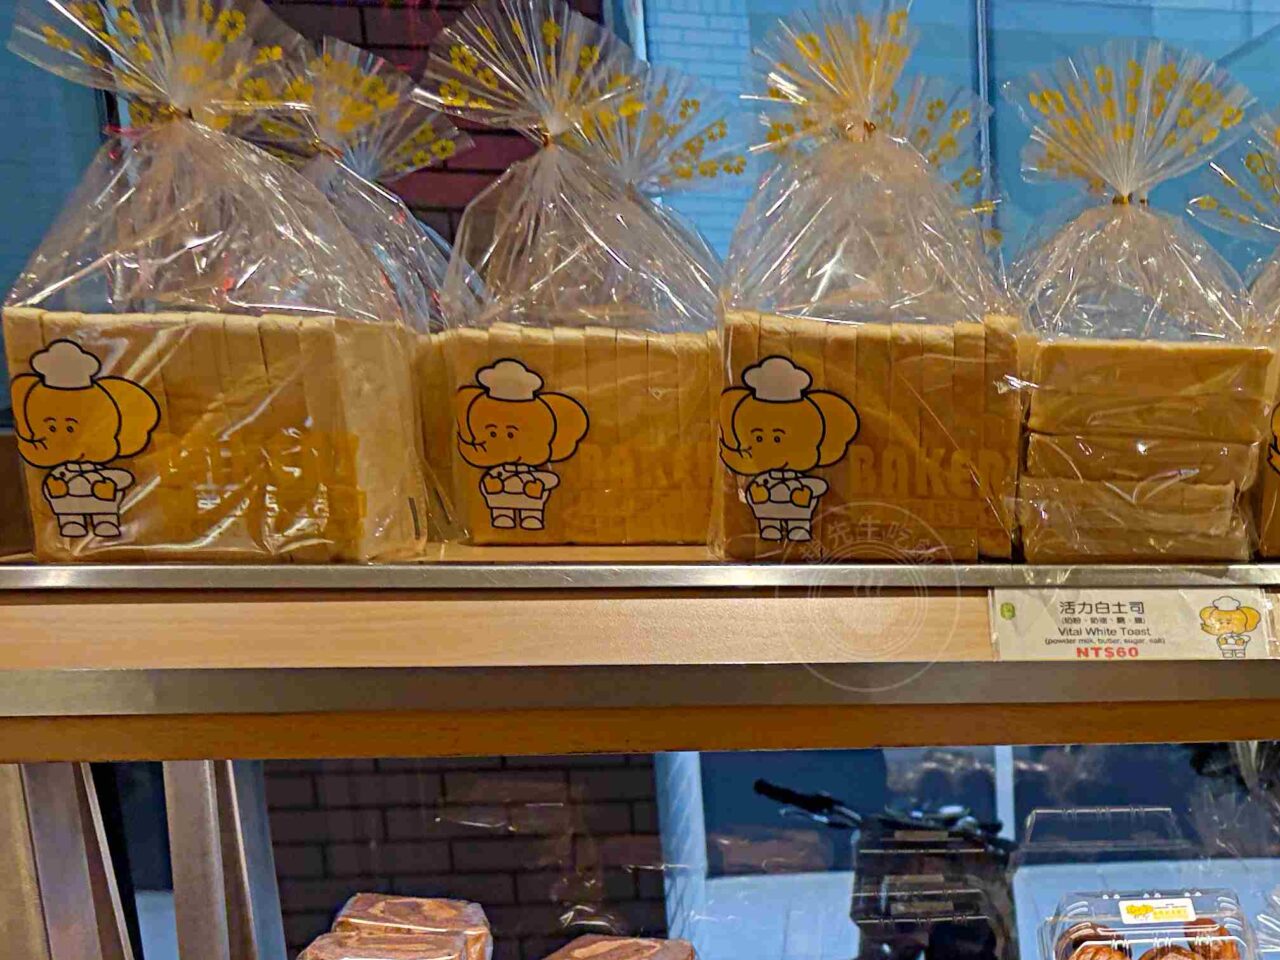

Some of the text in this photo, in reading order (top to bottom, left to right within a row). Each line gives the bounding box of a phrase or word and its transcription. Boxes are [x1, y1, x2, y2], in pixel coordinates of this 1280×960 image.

[1059, 601, 1145, 615] 活力白土司
[1058, 627, 1152, 637] Vital White Toast
[1076, 646, 1139, 659] NT$60
